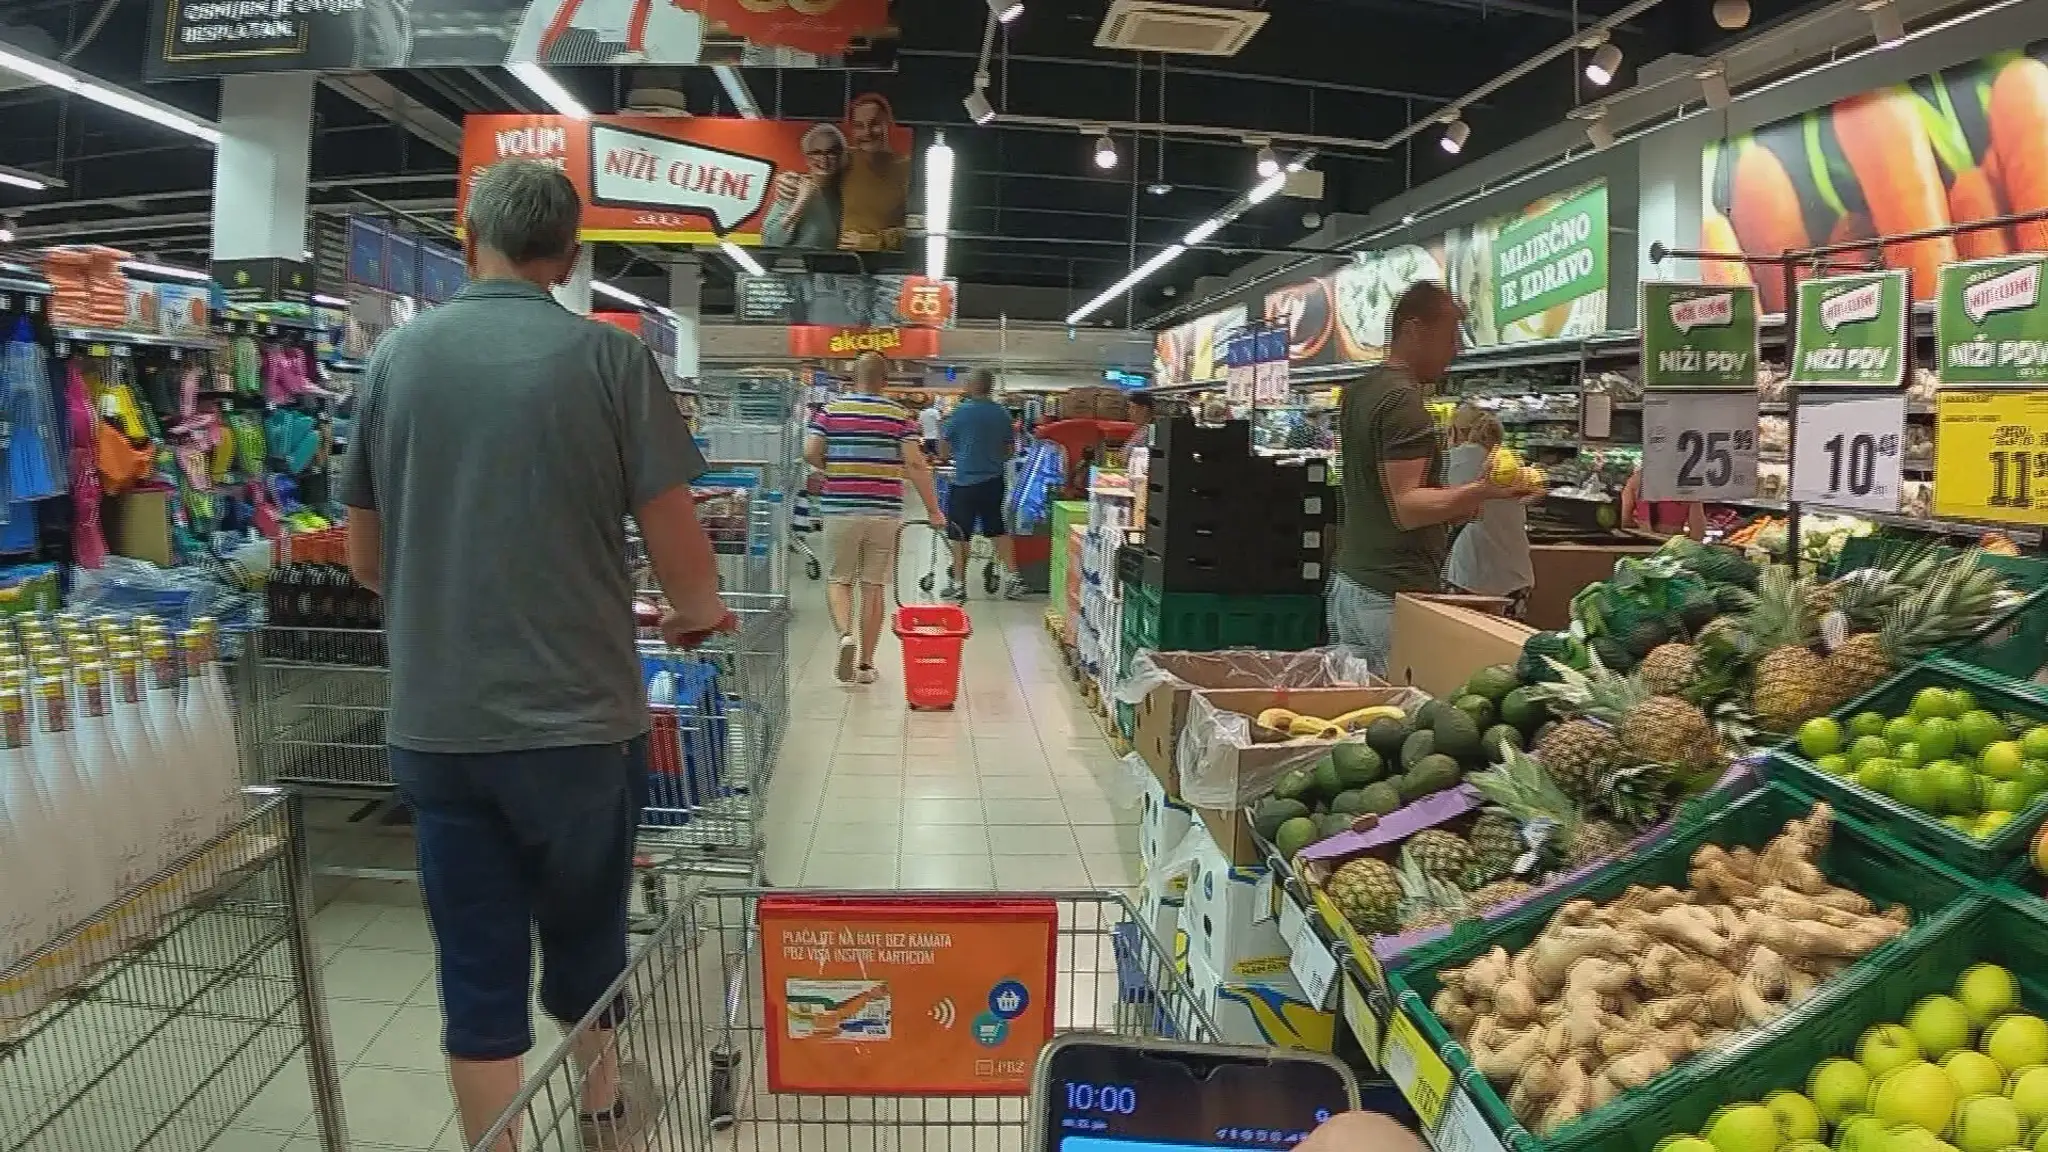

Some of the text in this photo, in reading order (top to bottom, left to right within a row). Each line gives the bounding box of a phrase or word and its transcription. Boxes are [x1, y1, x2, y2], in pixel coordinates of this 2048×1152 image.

[496, 127, 566, 157] VOLIM
[604, 147, 756, 202] NIŽE CIJENE
[1500, 212, 1591, 278] MLIJEČNO
[1500, 249, 1594, 310] JE ZDRAVO
[829, 328, 902, 353] akcija!
[1947, 334, 1996, 368] NIŽI
[1658, 344, 1749, 374] NIŽI PDV
[1802, 344, 1892, 372] NIŽI PDV
[1676, 430, 1732, 489] 25
[1822, 433, 1877, 497] 10
[782, 927, 952, 950] PLAĆAJTE NA RATE BEZ KAMATA
[783, 947, 803, 962] PBZ
[835, 948, 875, 964] INSPIRE
[878, 949, 935, 966] KARTICOM
[1065, 1083, 1136, 1115] 10:00
